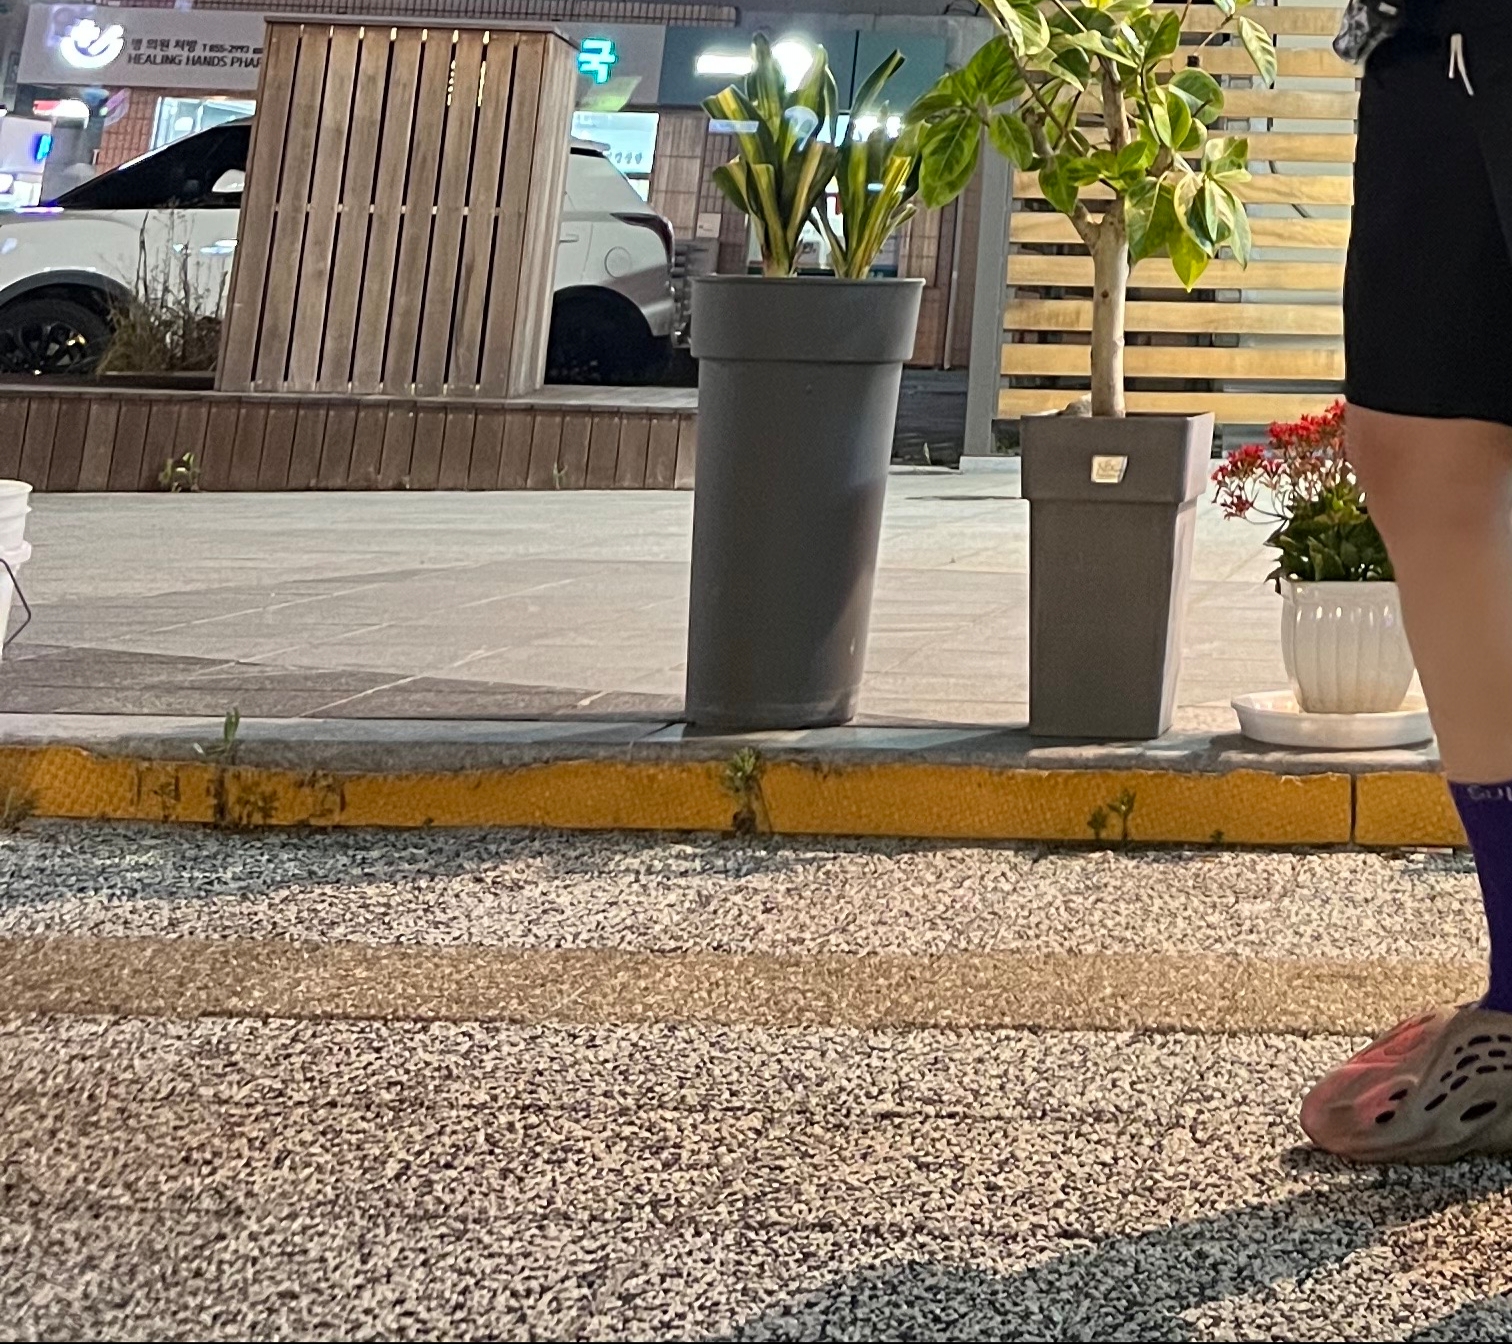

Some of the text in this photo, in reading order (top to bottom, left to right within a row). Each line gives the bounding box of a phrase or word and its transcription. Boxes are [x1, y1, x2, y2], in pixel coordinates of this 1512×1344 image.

[127, 52, 183, 66] HEALING
[185, 55, 228, 68] HANDS
[577, 36, 619, 84] 국
